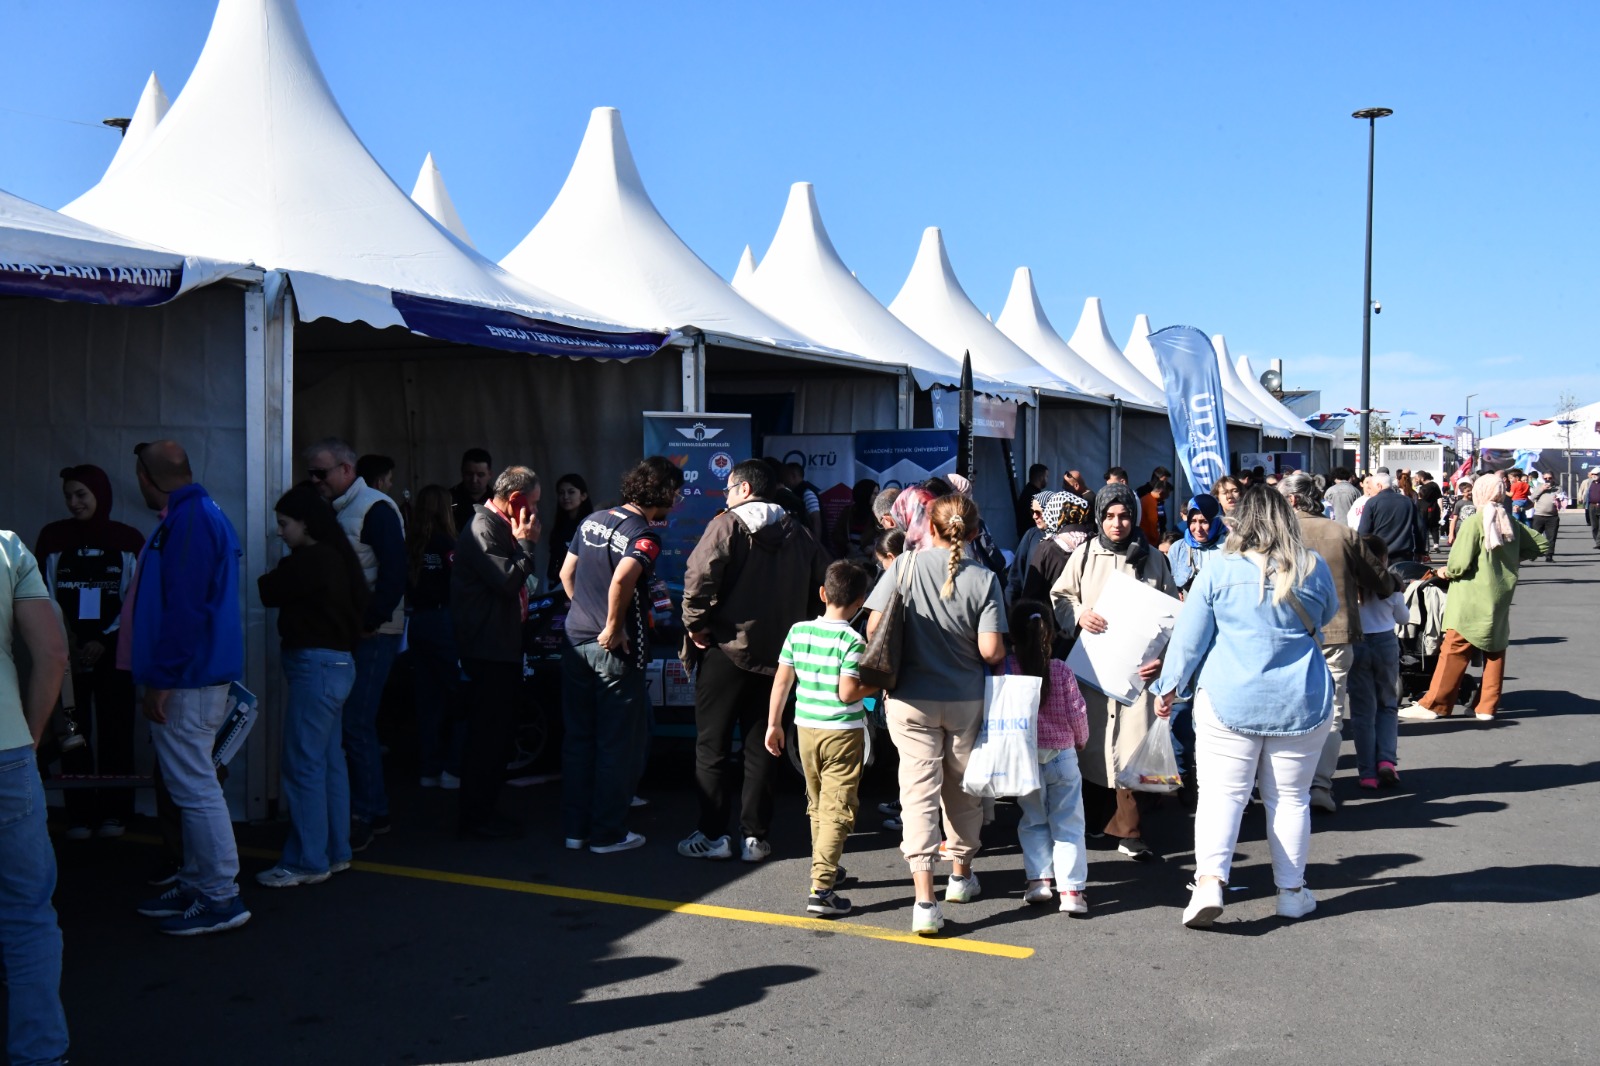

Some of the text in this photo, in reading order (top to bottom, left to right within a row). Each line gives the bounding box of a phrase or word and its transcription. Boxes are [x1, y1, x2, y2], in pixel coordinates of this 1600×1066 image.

[107, 267, 172, 288] TAKIMI
[485, 325, 530, 340] ENERJİ
[808, 451, 837, 466] KTÜ
